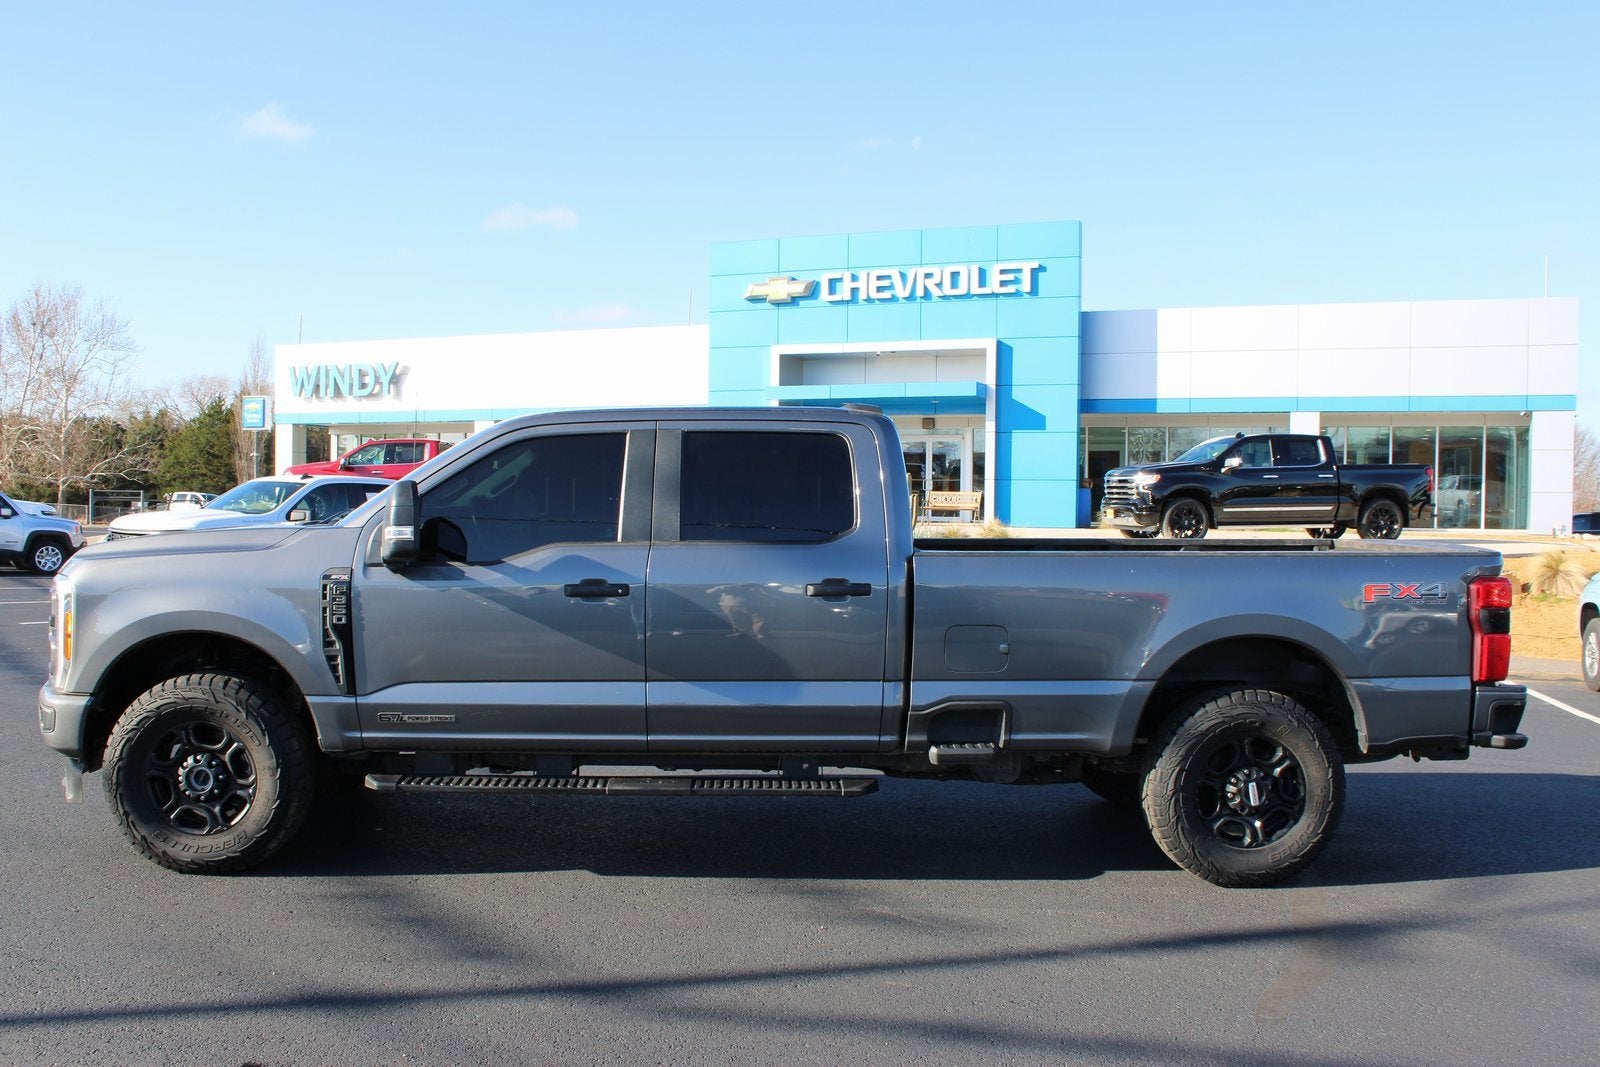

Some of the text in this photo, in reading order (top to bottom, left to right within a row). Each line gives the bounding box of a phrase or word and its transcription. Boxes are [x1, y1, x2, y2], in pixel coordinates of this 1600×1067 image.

[820, 261, 1041, 302] CHEVROLET
[288, 361, 400, 398] WINDY
[1362, 582, 1448, 605] FX4
